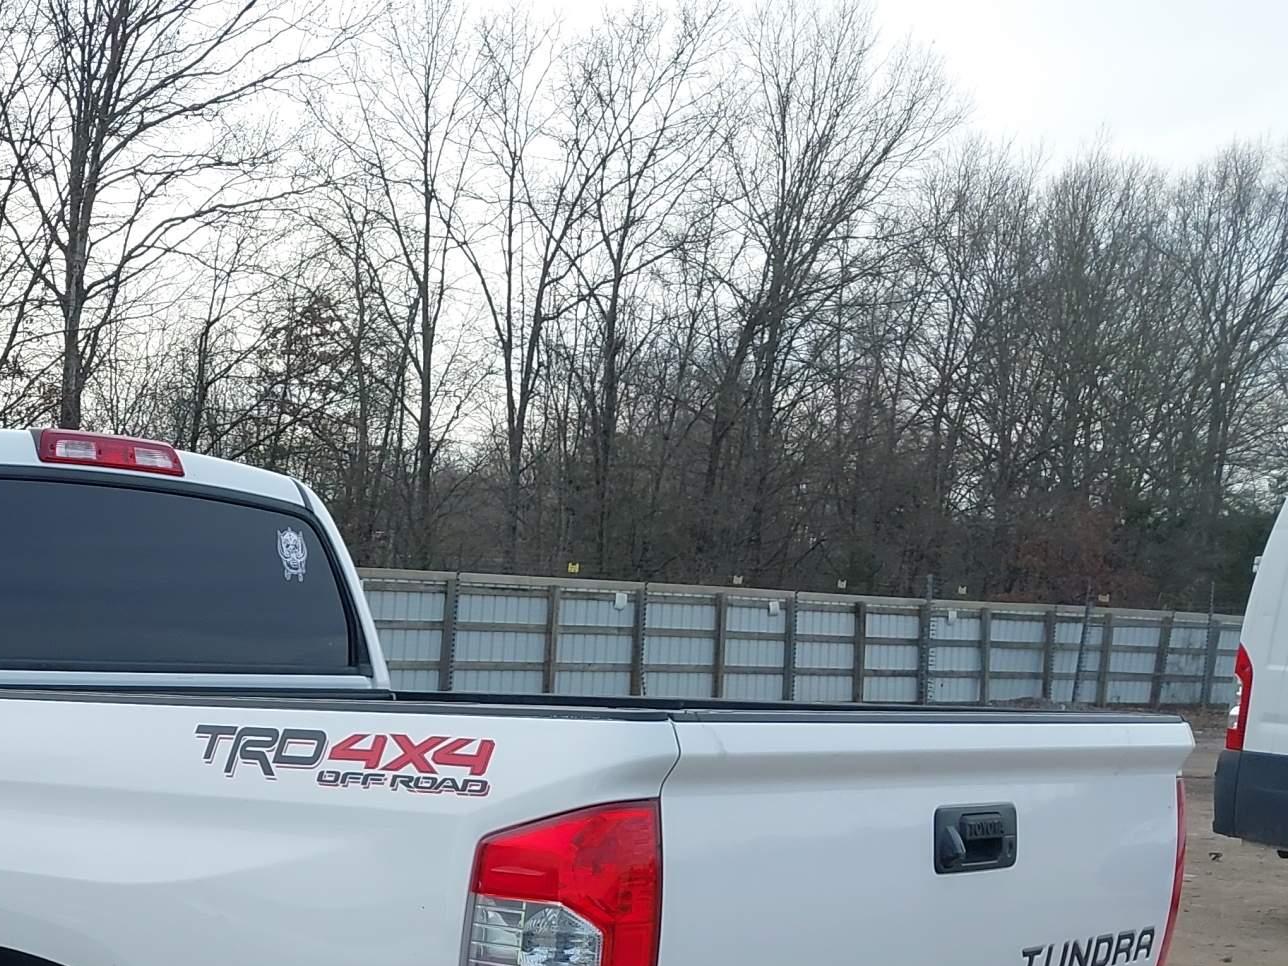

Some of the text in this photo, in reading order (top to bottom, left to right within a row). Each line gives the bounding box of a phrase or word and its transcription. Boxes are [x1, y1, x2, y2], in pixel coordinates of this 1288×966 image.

[195, 724, 496, 780] TRD 4X4
[316, 770, 490, 797] OFF ROAD
